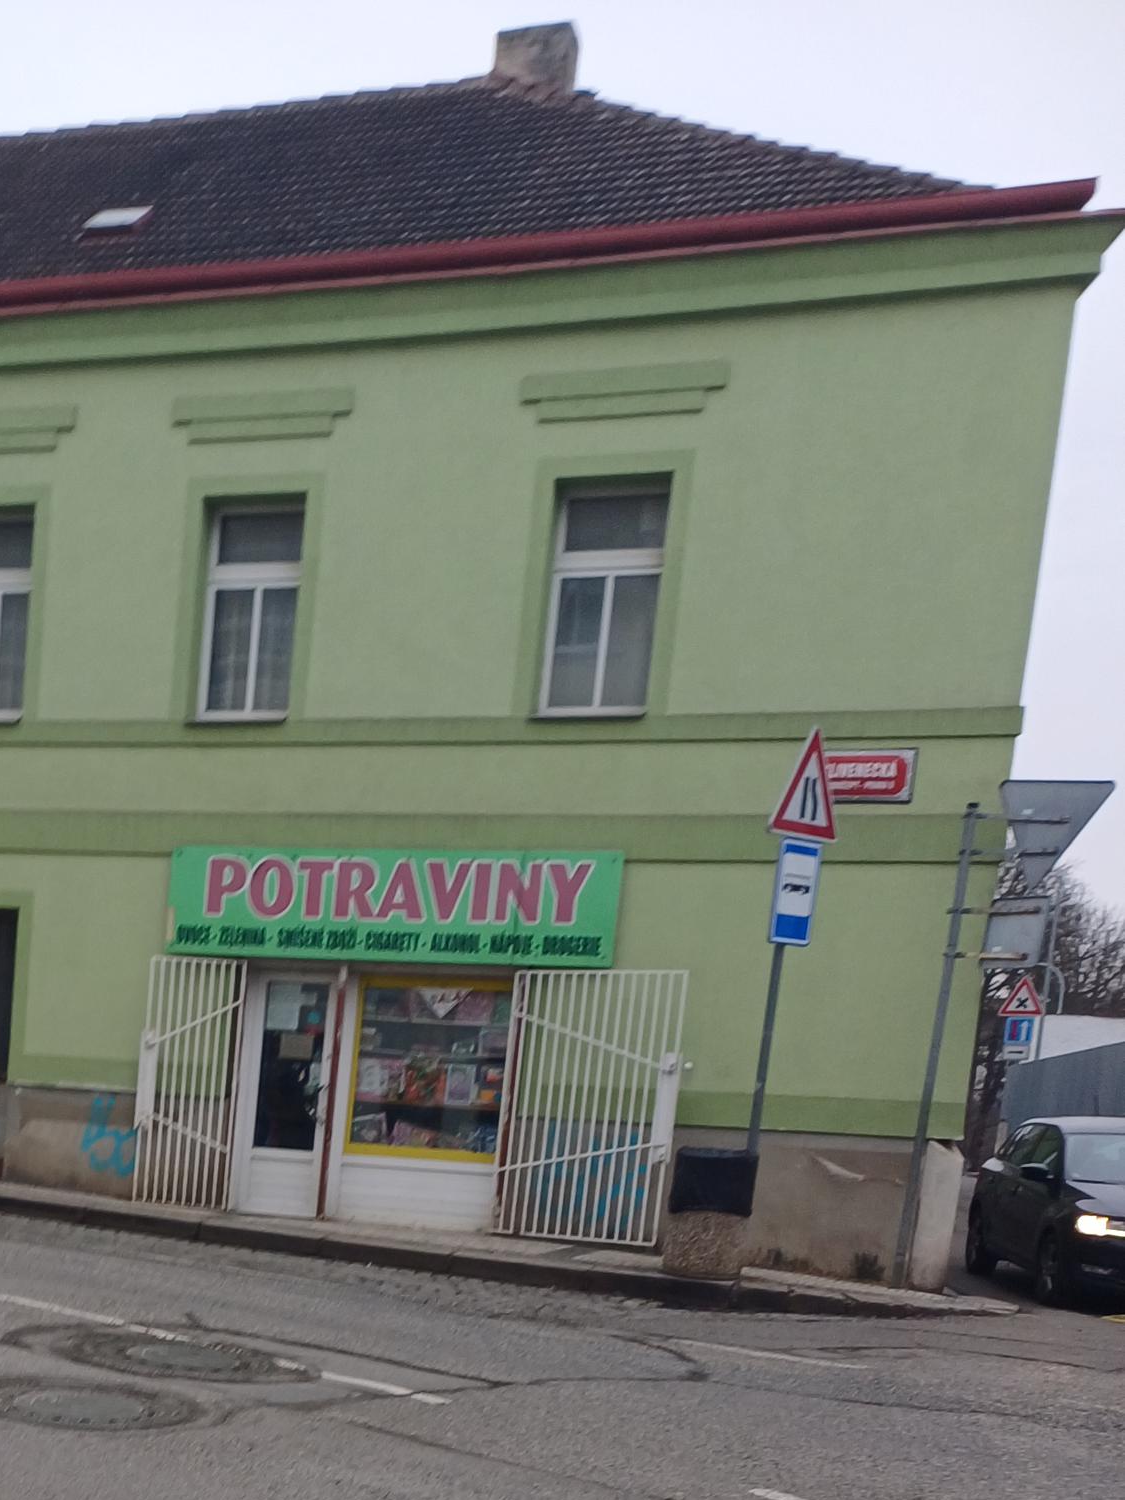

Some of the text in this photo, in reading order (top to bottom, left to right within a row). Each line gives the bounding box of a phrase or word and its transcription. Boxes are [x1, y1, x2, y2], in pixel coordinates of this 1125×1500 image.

[203, 856, 594, 926] POTRAVINY
[176, 924, 211, 945] OVOCE
[218, 925, 266, 948] ZELENINA
[363, 930, 420, 952] CIGARETY
[429, 933, 480, 953] ALKOHOL
[541, 935, 602, 956] DROGERIE
